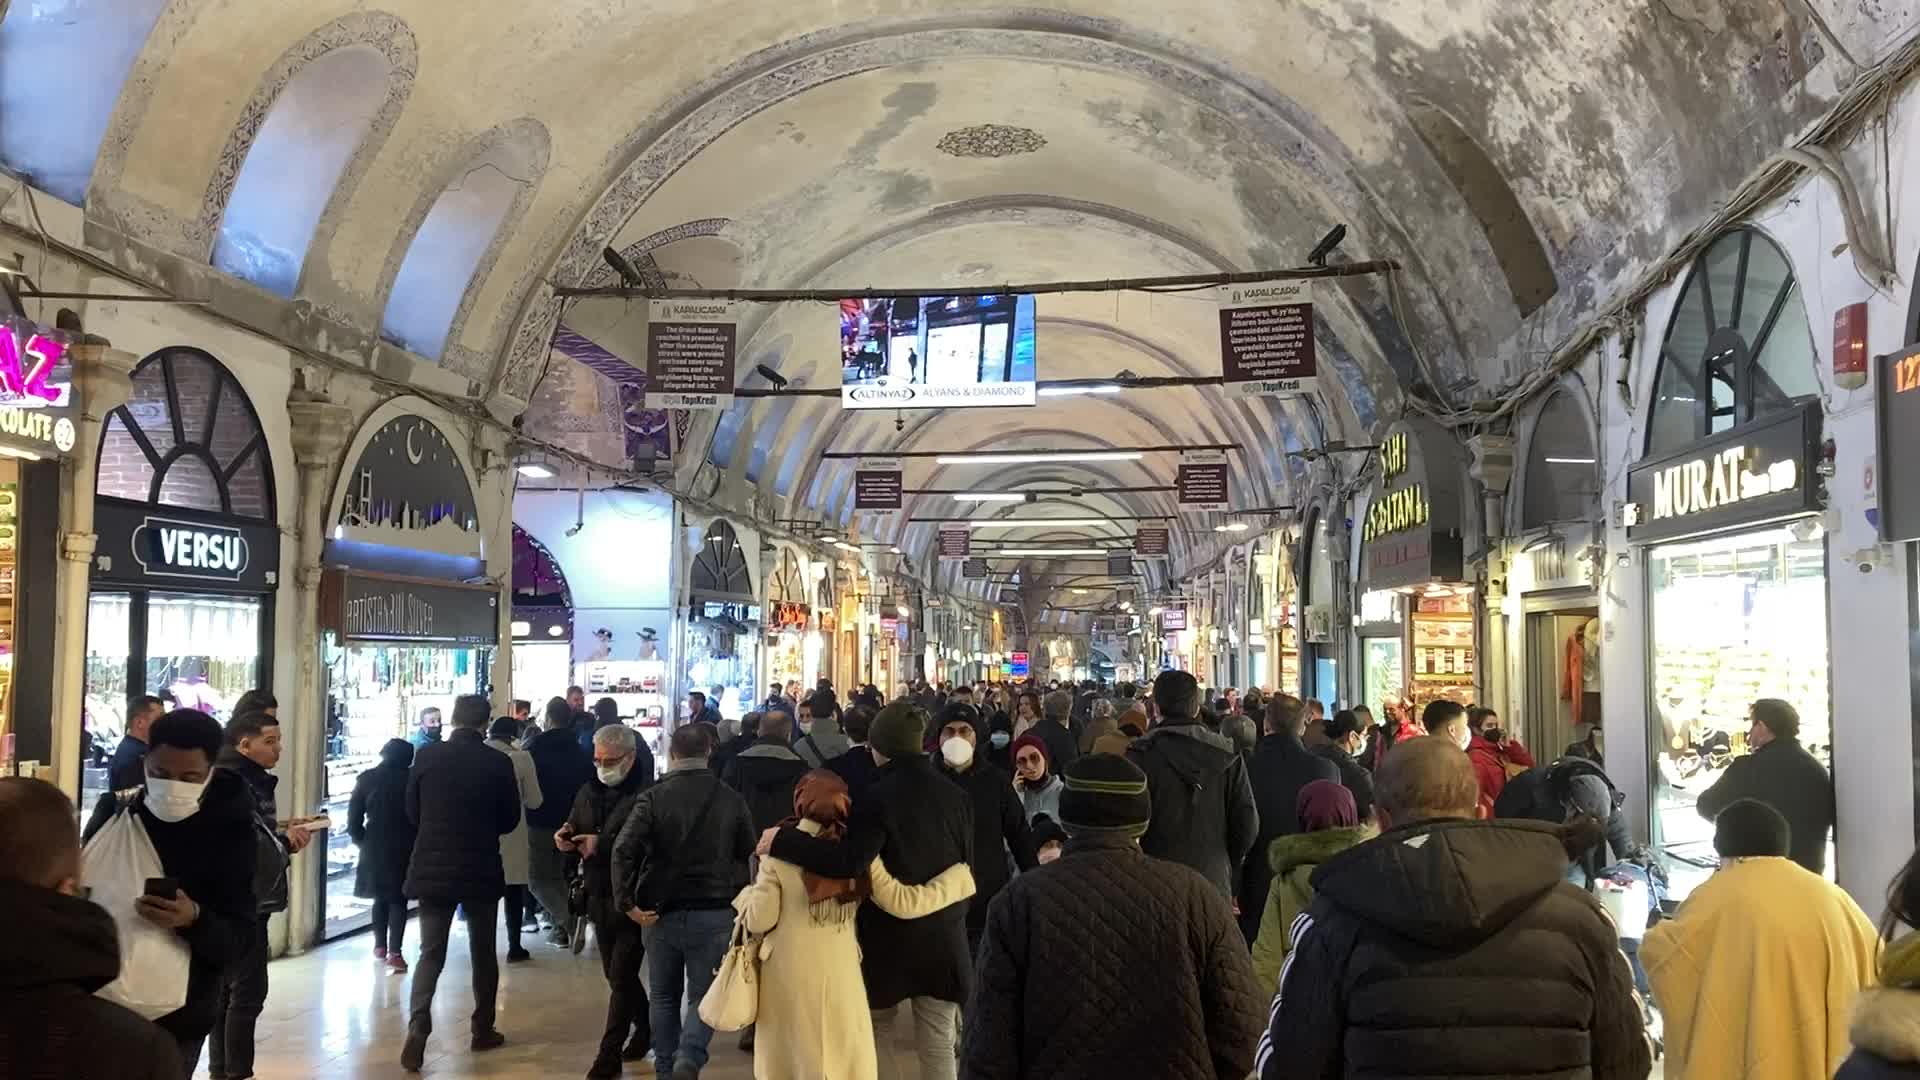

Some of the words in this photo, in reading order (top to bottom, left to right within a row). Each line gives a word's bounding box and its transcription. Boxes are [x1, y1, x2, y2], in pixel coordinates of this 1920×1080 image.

[857, 390, 907, 399] ALTINYAZ
[922, 388, 961, 397] ALYANS
[963, 388, 971, 397] &
[973, 386, 1026, 396] DIAMOND
[1653, 446, 1744, 519] MURAT
[160, 528, 240, 570] VERSU
